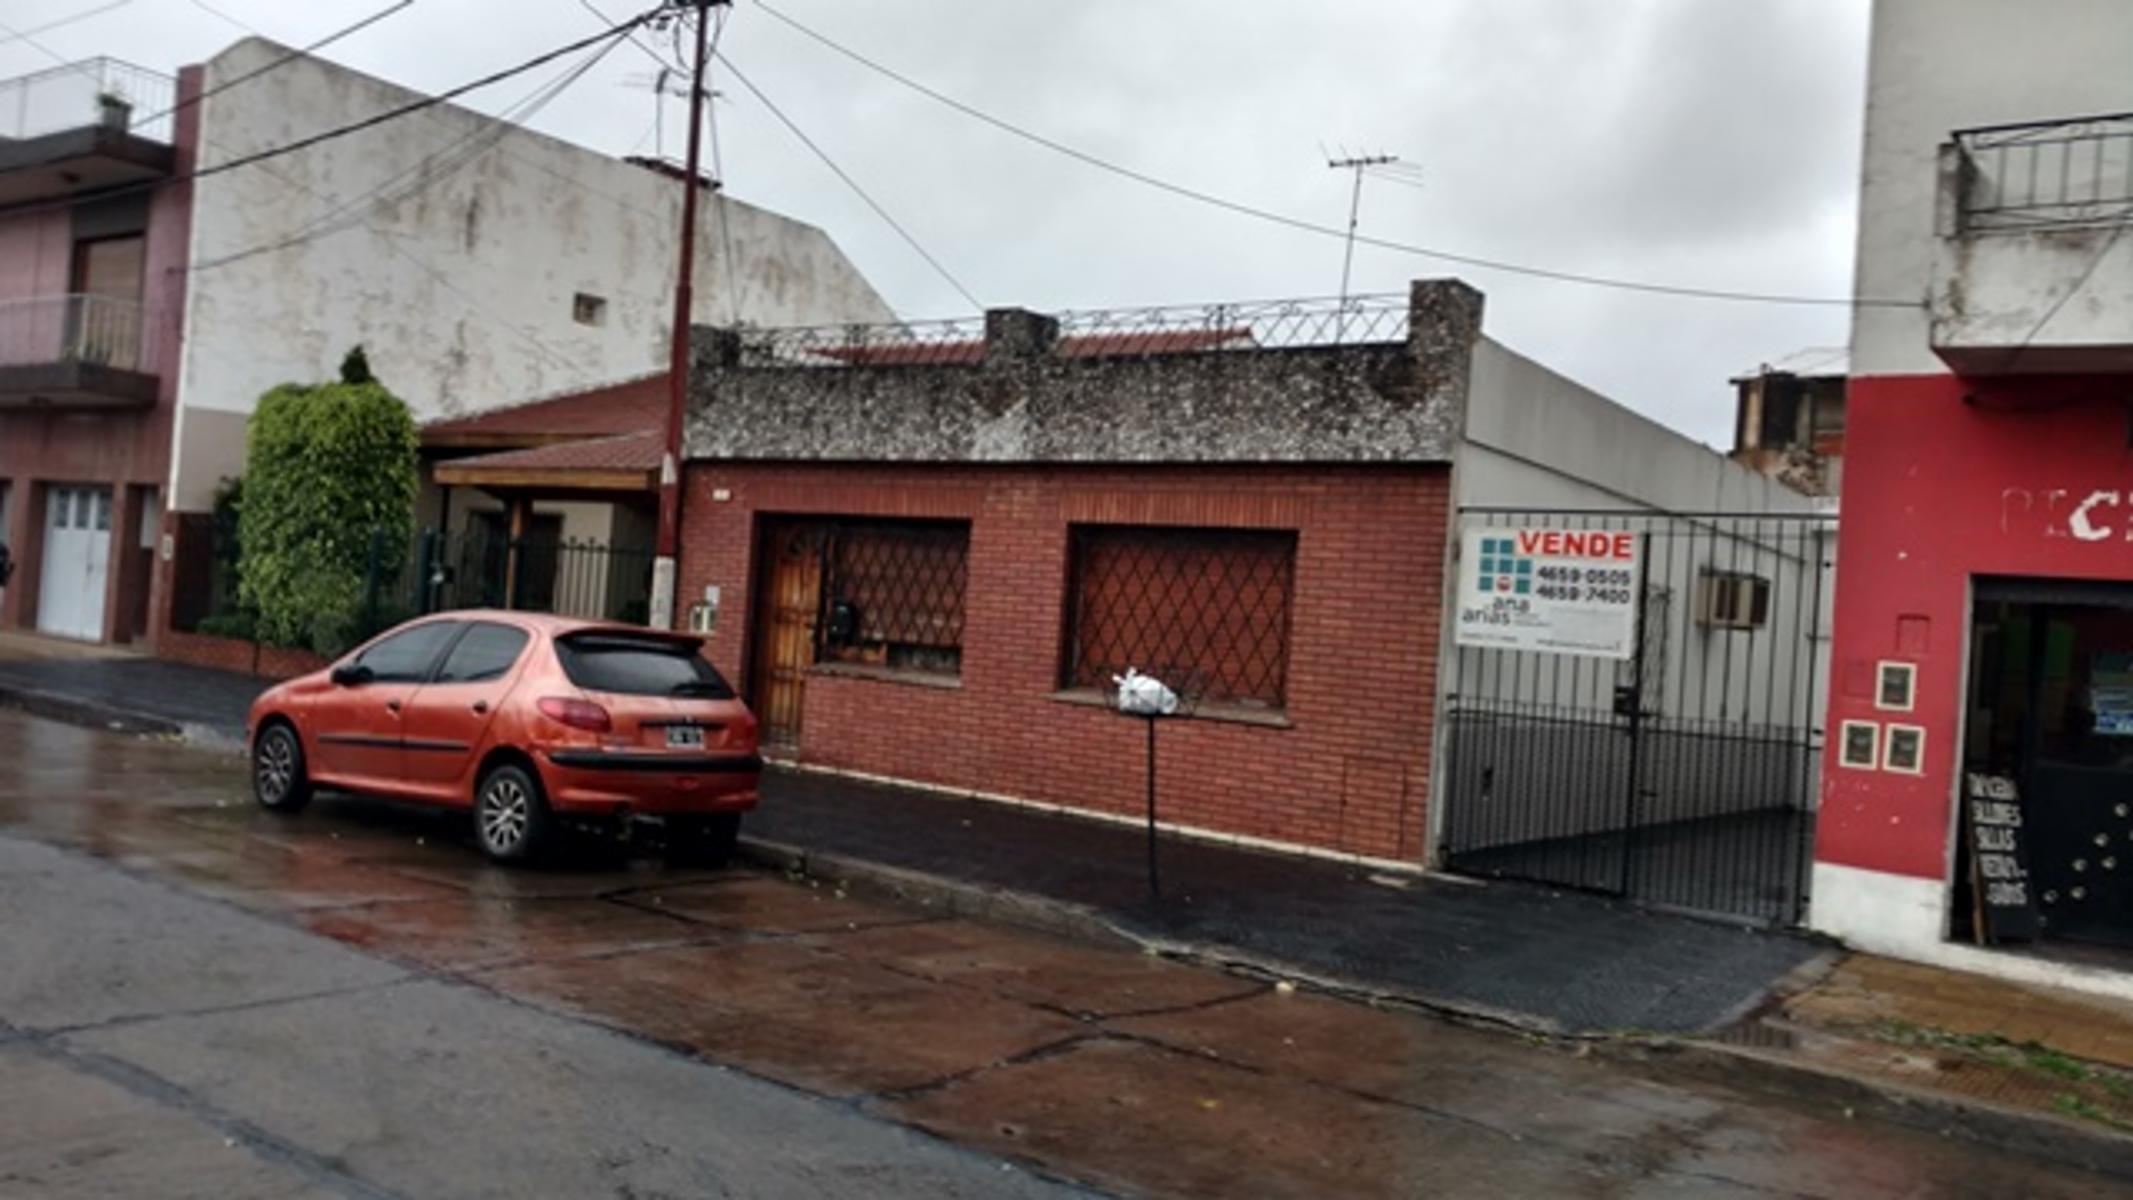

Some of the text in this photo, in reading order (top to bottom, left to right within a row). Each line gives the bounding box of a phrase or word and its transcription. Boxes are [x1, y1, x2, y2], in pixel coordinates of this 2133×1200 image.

[1519, 529, 1633, 560] VENDE
[1492, 597, 1531, 614] ana
[1461, 606, 1512, 626] arias
